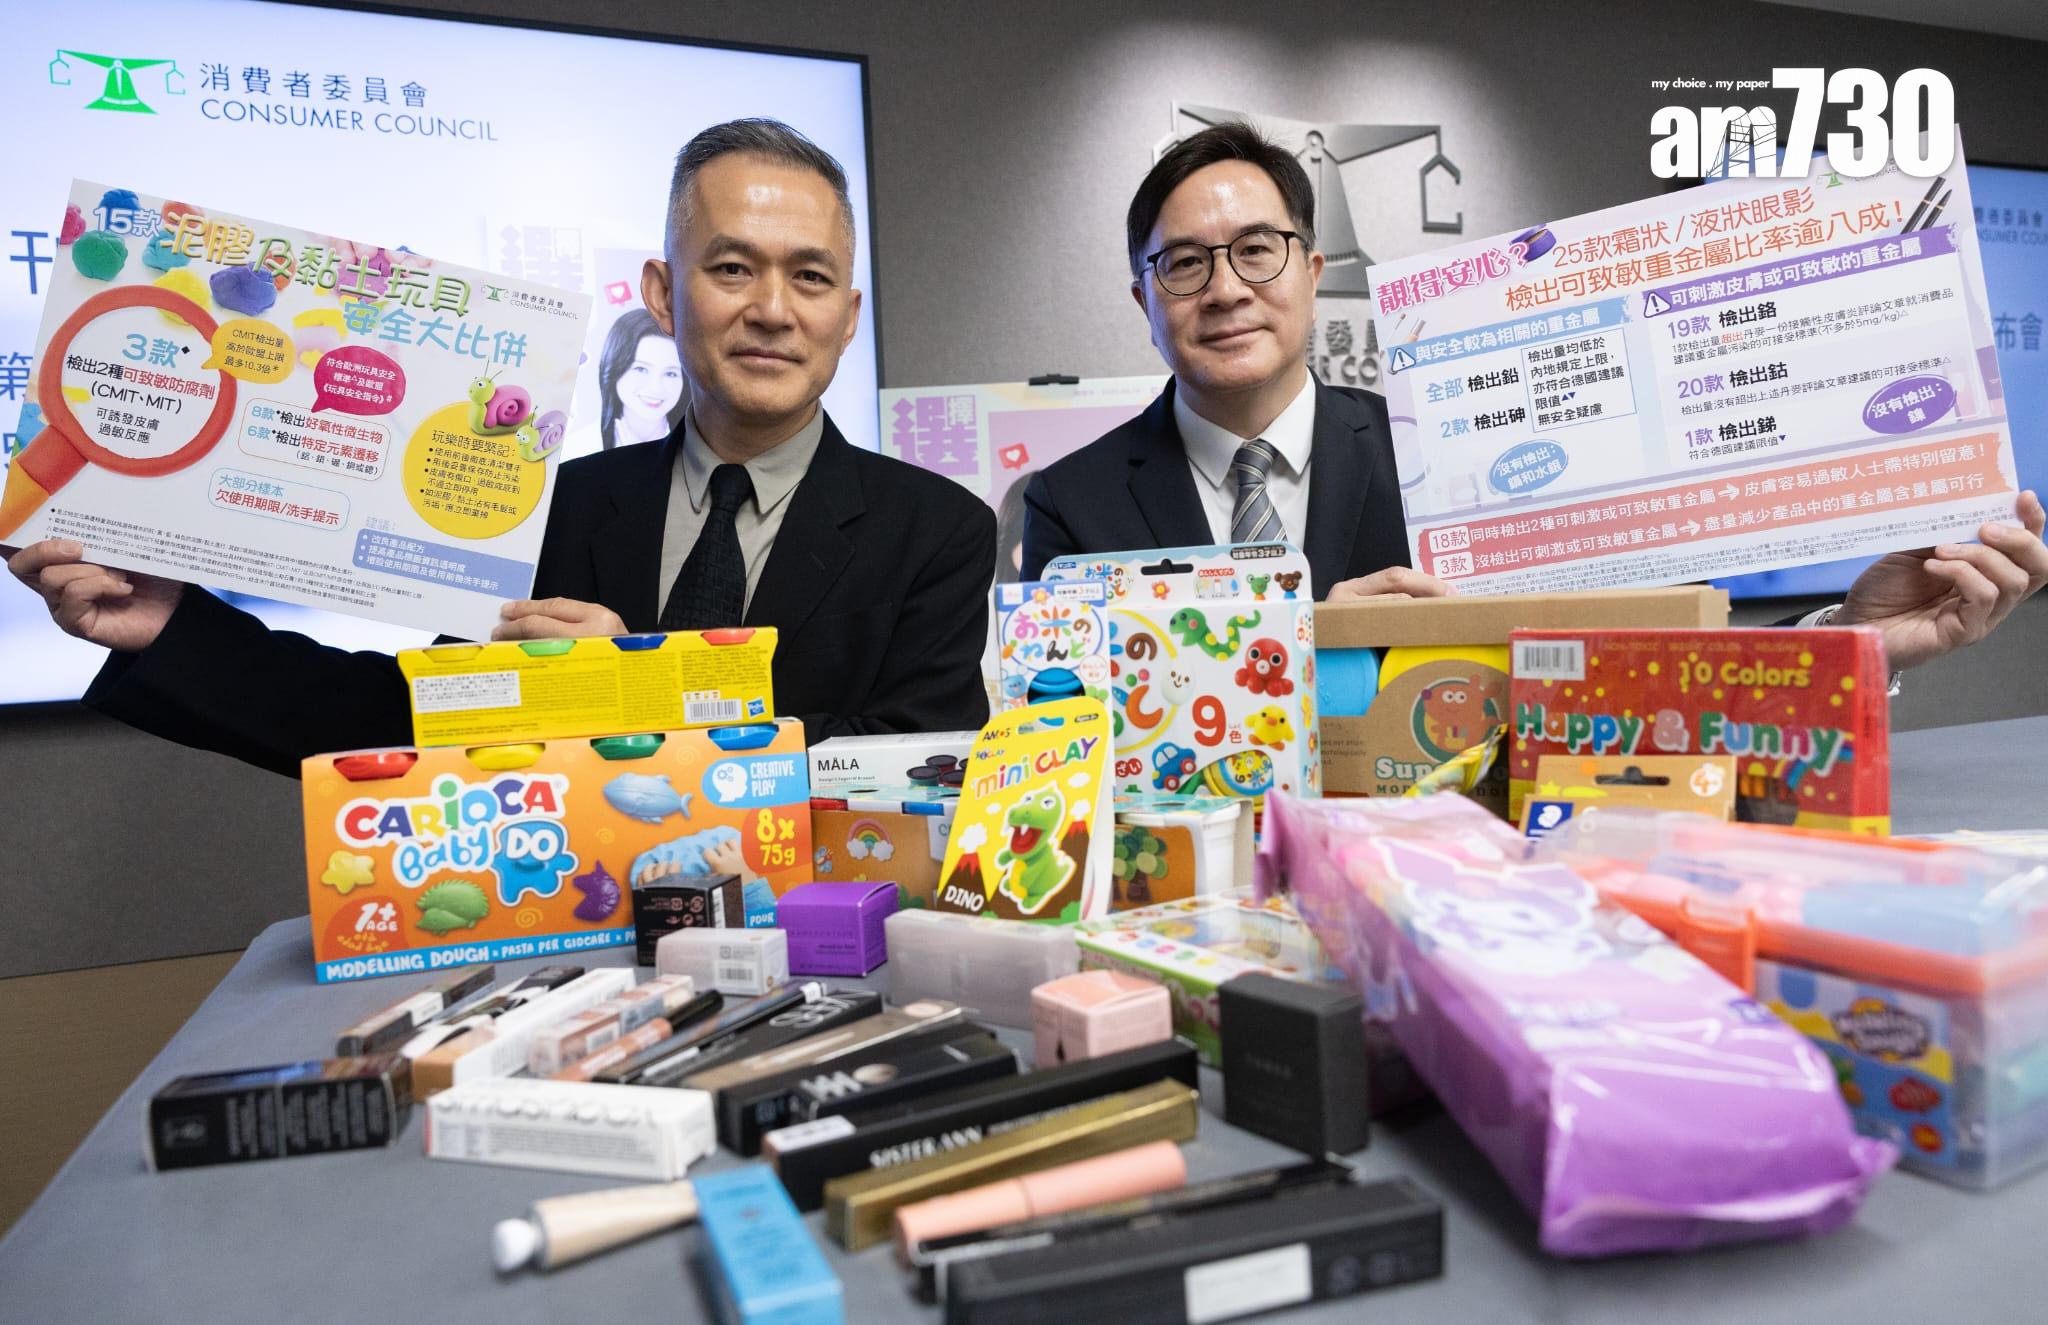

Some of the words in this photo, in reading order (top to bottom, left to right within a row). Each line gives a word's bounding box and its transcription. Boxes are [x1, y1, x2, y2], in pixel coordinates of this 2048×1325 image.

[200, 63, 429, 109] 消費者委員會
[201, 98, 364, 131] CONSUMER
[375, 112, 499, 141] COUNCIL
[1552, 185, 1815, 268] 25款霜狀/液狀眼影
[93, 206, 163, 239] 15款
[160, 209, 472, 318] 泥膠及黏土玩具
[1670, 236, 1922, 306] 可刺激皮膚或可致敏的重金屬
[510, 299, 548, 313] CONSUMER
[548, 307, 579, 320] COUNCIL
[511, 290, 564, 309] 消費者委員會
[1415, 307, 1600, 363] 與安全較為相關的重金屬
[1667, 314, 1712, 339] 19款
[1718, 301, 1777, 329] 檢出鉻
[122, 333, 181, 369] 3款
[225, 341, 285, 363] 高於歐盟上限
[232, 328, 285, 348] CMIT檢出量
[1527, 336, 1606, 363] 檢出量均低於
[66, 354, 216, 400] 檢出2種可致敏防腐劑
[1425, 377, 1465, 404] 全部
[1467, 367, 1520, 393] 檢出鉛
[1532, 365, 1625, 395] 亦符合德國建議
[1677, 374, 1725, 399] 20款
[1729, 361, 1788, 389] 檢出鈷
[251, 405, 274, 421] 8款
[1534, 394, 1562, 411] 限值
[1537, 402, 1603, 426] 無安全疑慮
[96, 407, 160, 431] 可誘發皮膚
[97, 422, 151, 444] 過敏反應
[247, 425, 270, 441] 6款
[1440, 416, 1471, 438] 2款
[1474, 406, 1526, 432] 檢出砷
[1684, 425, 1714, 448] 1款
[1718, 415, 1777, 442] 檢出銻
[1688, 435, 1779, 460] 符合德國建議限值
[219, 473, 285, 498] 大部分樣本
[215, 488, 340, 526] 欠使用期限/洗手提示
[1432, 529, 1467, 550] 18款
[1470, 488, 1716, 544] 同時檢出2種可刺激或可致敏重金屬
[1704, 473, 1985, 533] 盡量減少產品中的重金屬含量屬可行
[1440, 557, 1468, 576] 3款
[1474, 523, 1679, 569] 沒檢出可刺激或可致敏重金屬
[1719, 659, 1811, 687] Colors
[1192, 694, 1227, 747] 9
[1515, 703, 1645, 755] Happy
[1653, 708, 1690, 753] &
[1699, 710, 1844, 777] Funny
[750, 759, 796, 778] CREATIVE
[975, 755, 1031, 799] mini
[1034, 736, 1099, 775] CLAY
[751, 779, 776, 797] PLAY
[756, 807, 796, 844] 8x
[507, 828, 560, 860] DO
[760, 844, 796, 867] 75g
[944, 884, 986, 912] DINO
[354, 901, 398, 933] 1+
[366, 920, 399, 932] AGE
[325, 955, 425, 981] MODELLING
[430, 945, 489, 967] DOUGH
[501, 942, 535, 957] PASTA
[537, 940, 560, 952] PER
[563, 932, 611, 949] GIOCARE
[750, 911, 775, 927] POUR
